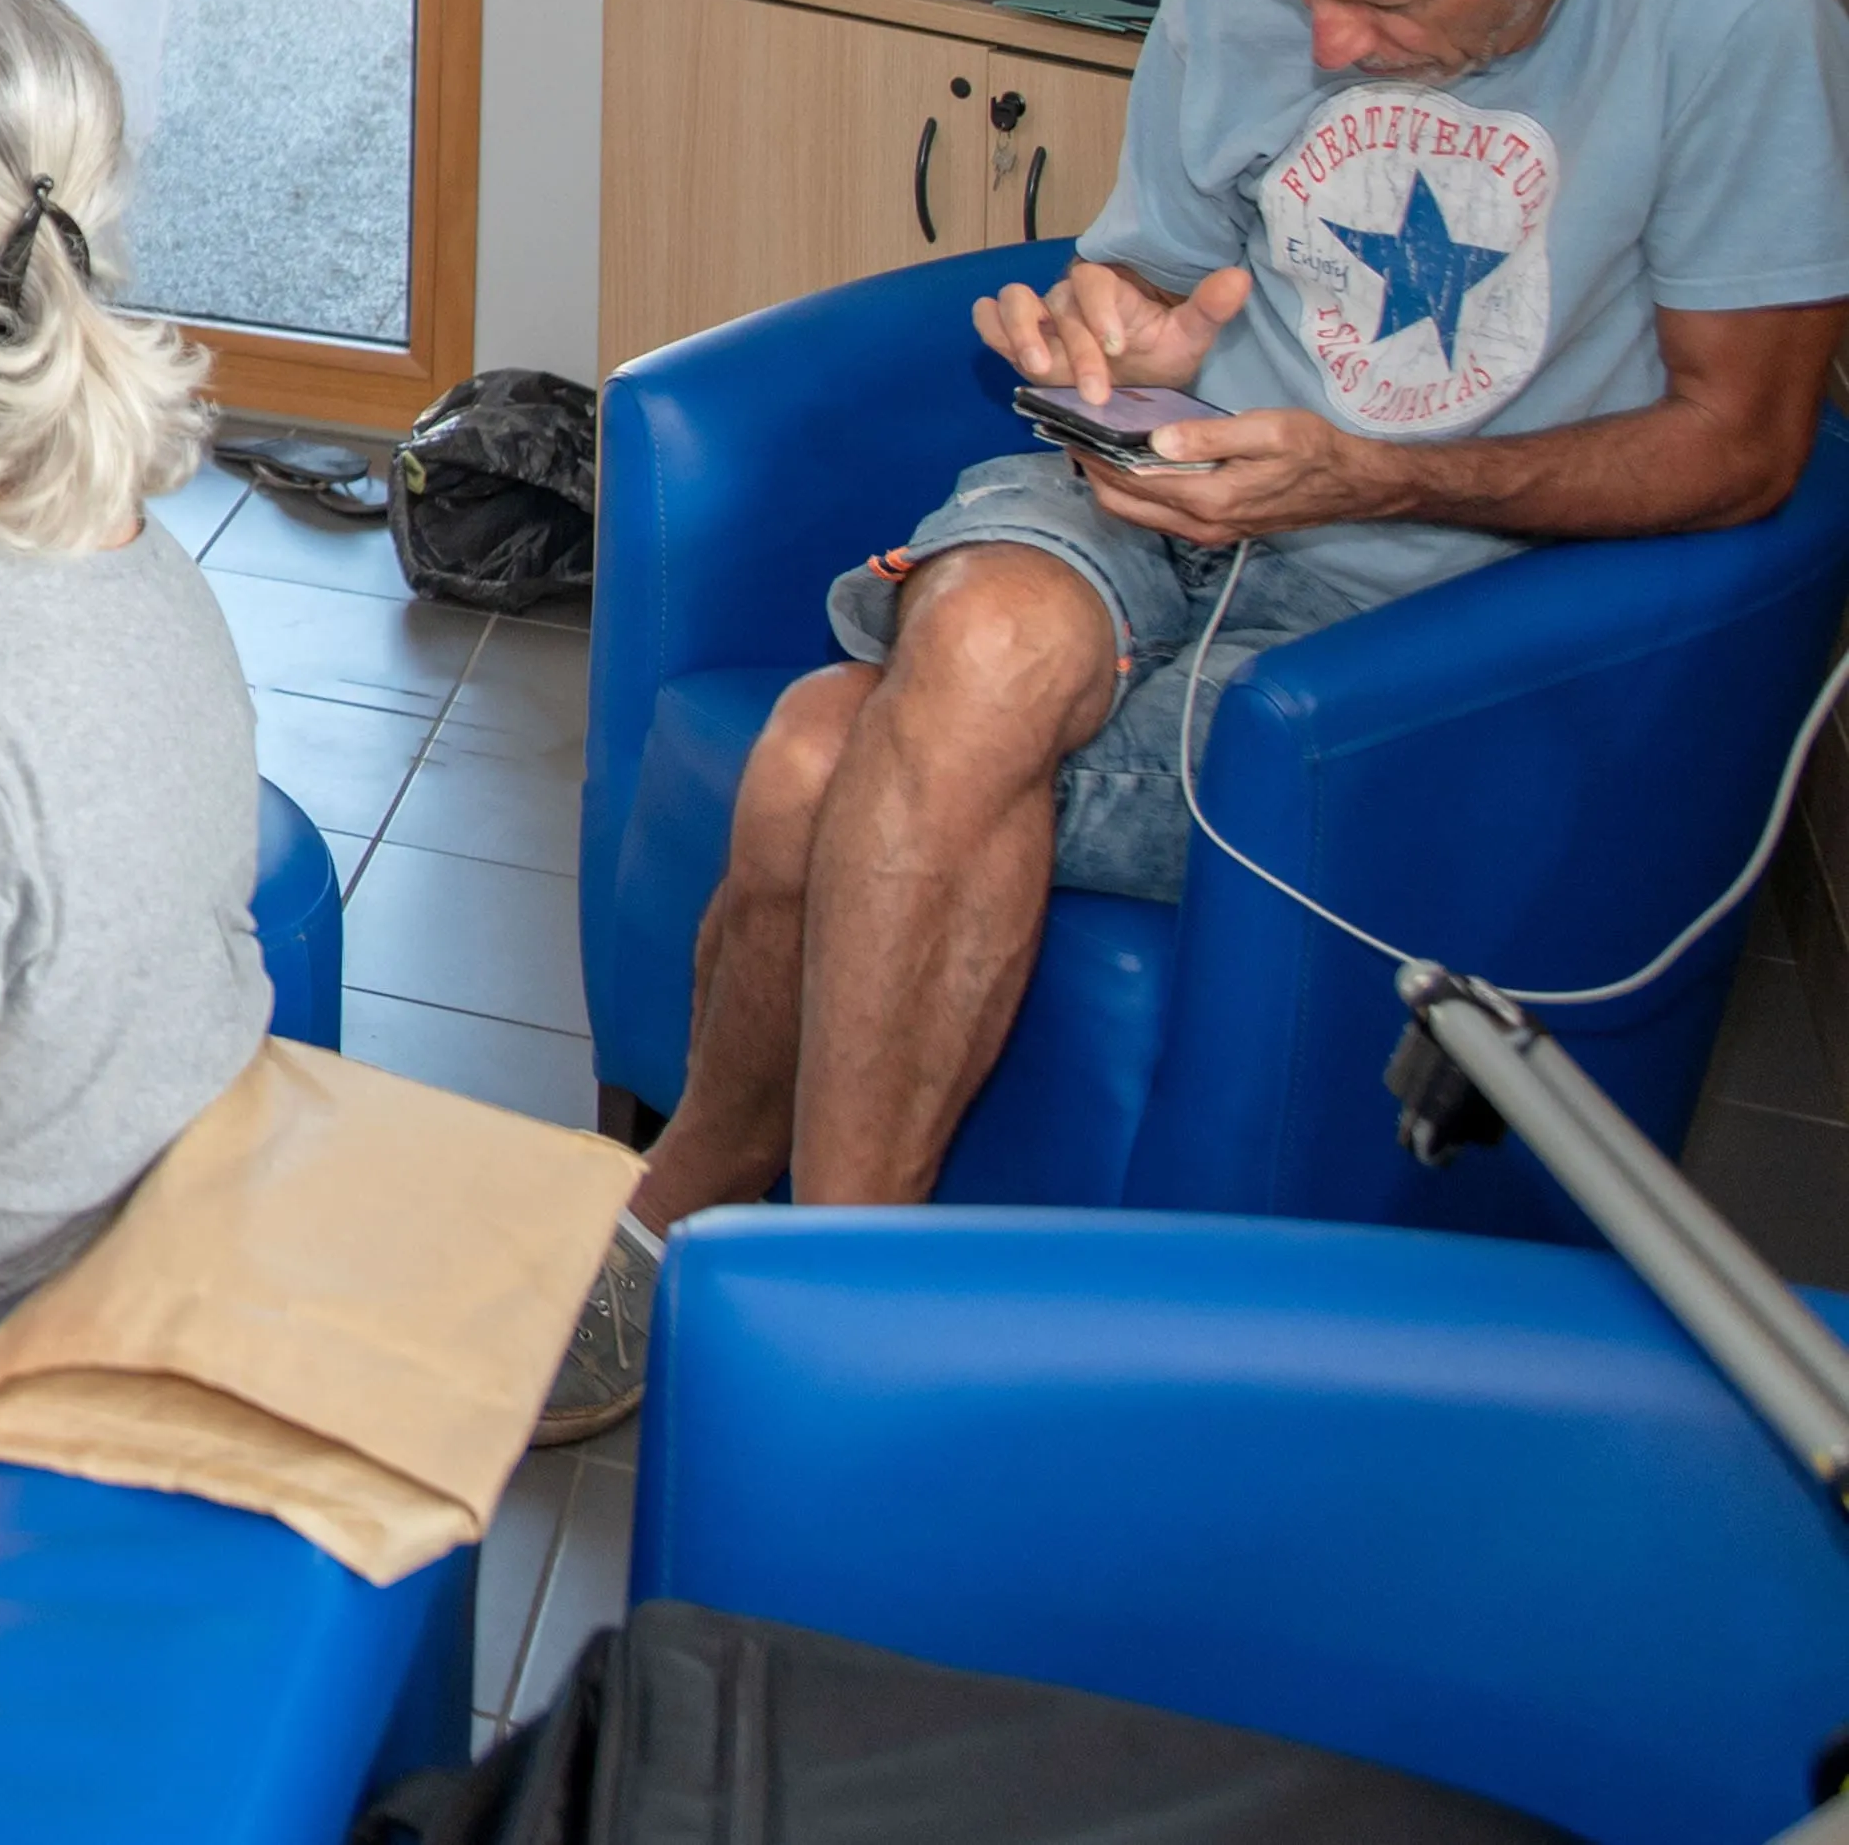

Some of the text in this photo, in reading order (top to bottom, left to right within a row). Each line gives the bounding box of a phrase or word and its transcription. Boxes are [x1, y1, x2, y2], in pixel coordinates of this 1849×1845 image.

[1286, 237, 1350, 293] Enjoy
[1317, 304, 1493, 422] ISLAS CANARIAS
